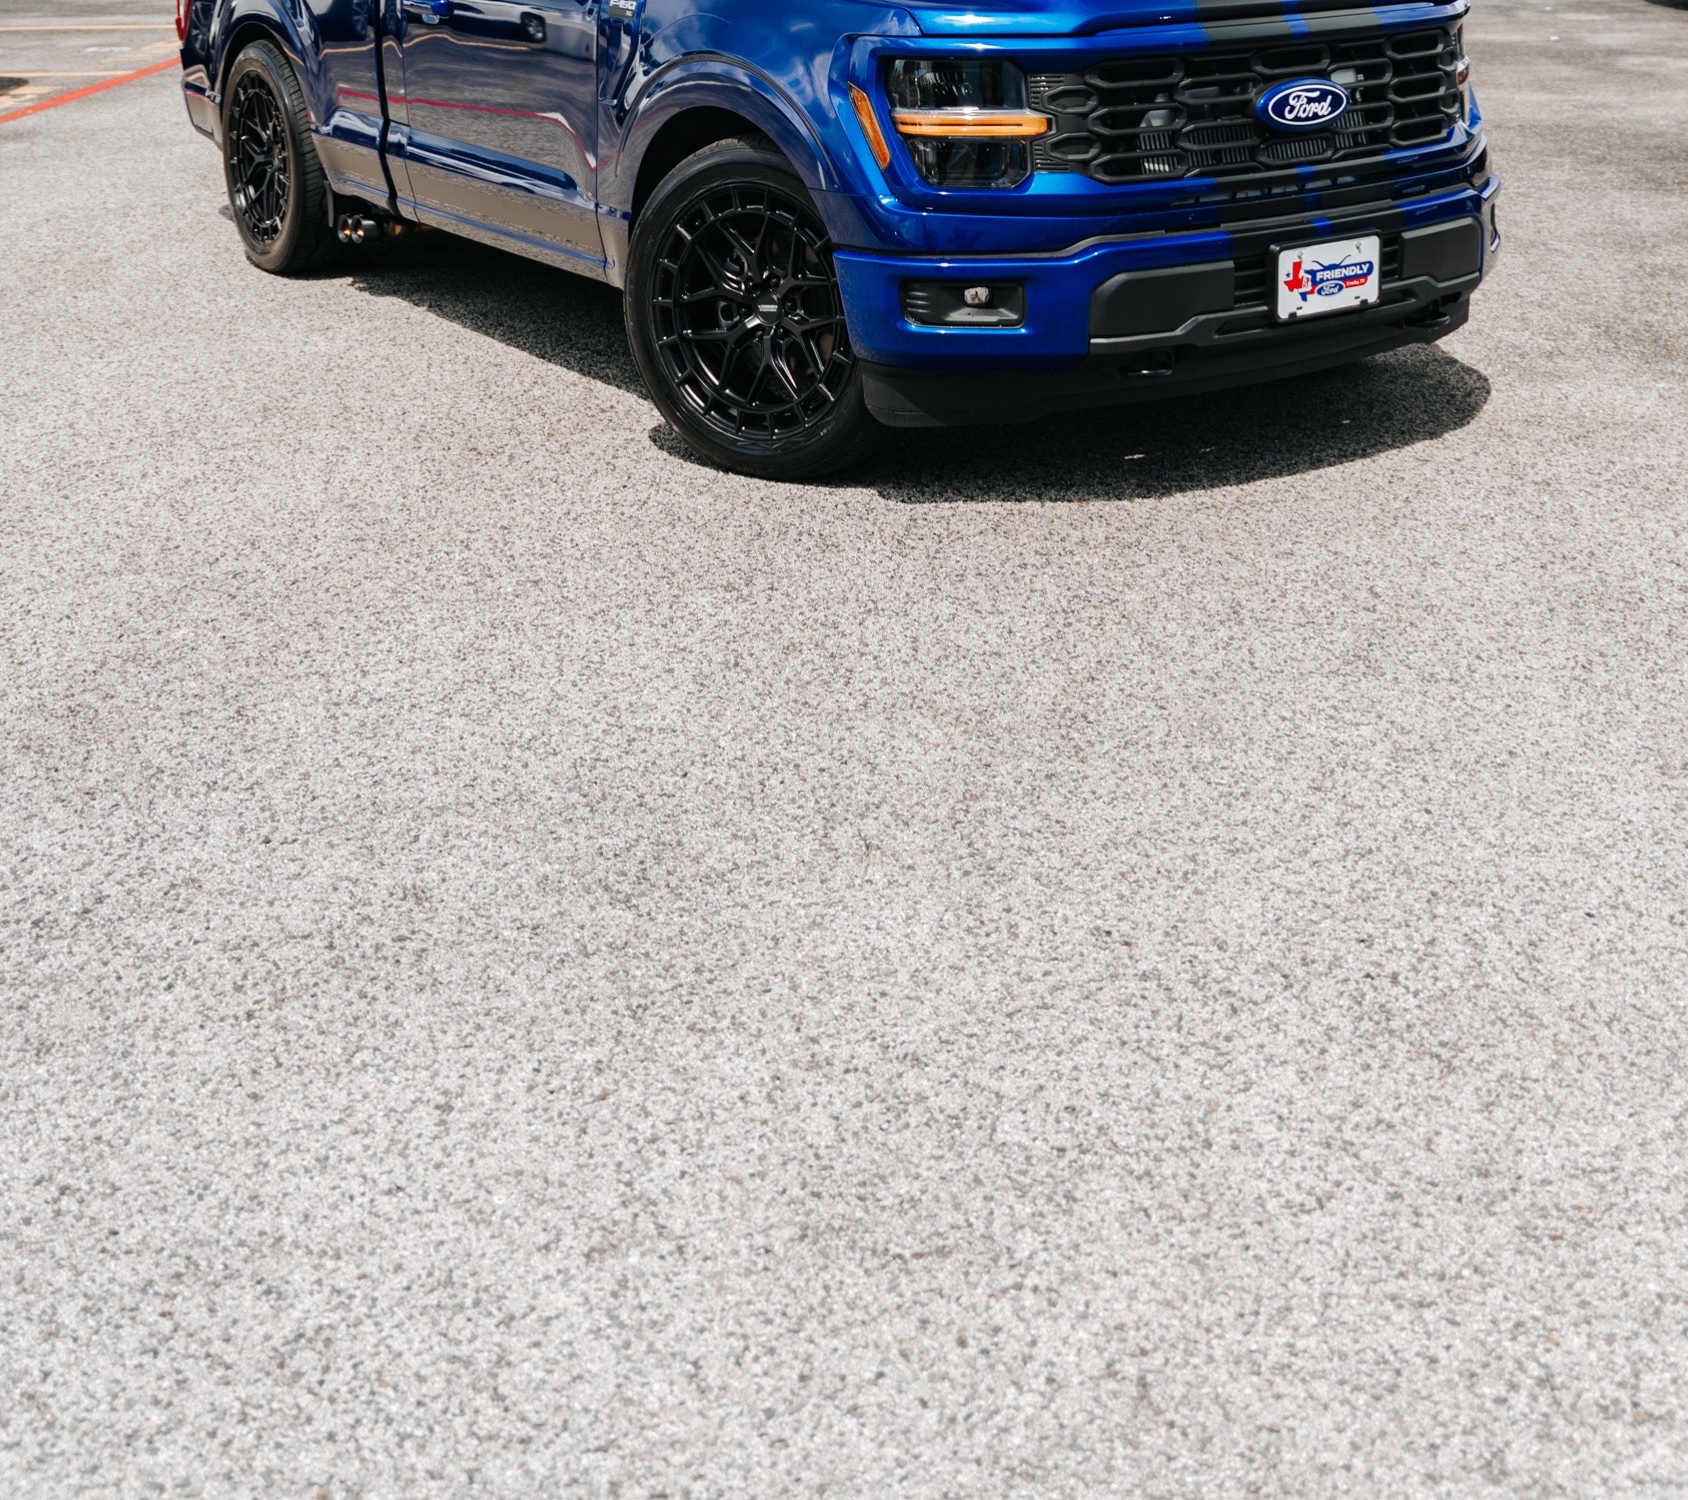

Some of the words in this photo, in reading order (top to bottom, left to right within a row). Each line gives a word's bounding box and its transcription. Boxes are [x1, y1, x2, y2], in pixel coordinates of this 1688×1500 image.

[1284, 90, 1332, 120] Ford
[1316, 263, 1370, 282] FRIENDLY
[1320, 283, 1340, 296] Ford
